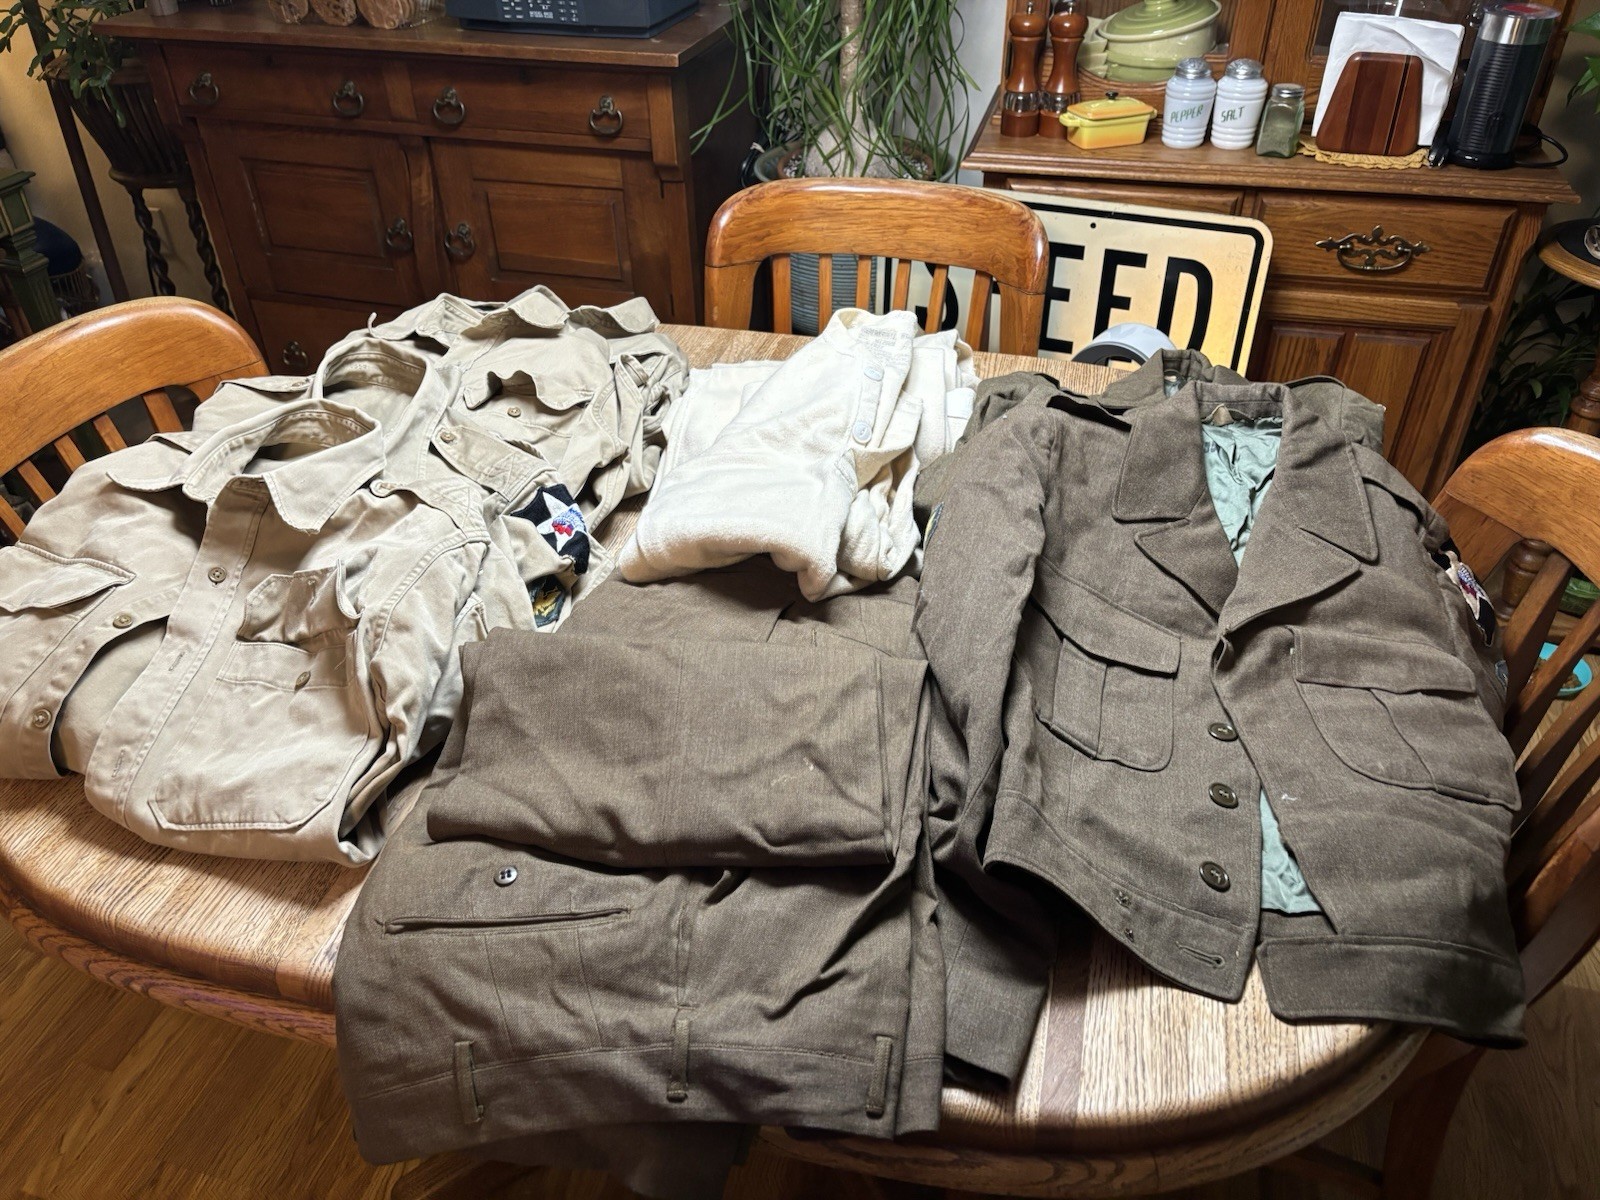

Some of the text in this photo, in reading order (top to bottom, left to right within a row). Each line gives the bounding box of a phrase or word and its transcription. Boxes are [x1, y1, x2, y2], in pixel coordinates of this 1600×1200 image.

[1170, 104, 1204, 122] PEPPER
[1221, 106, 1245, 122] SALT
[914, 241, 1213, 366] SEED
